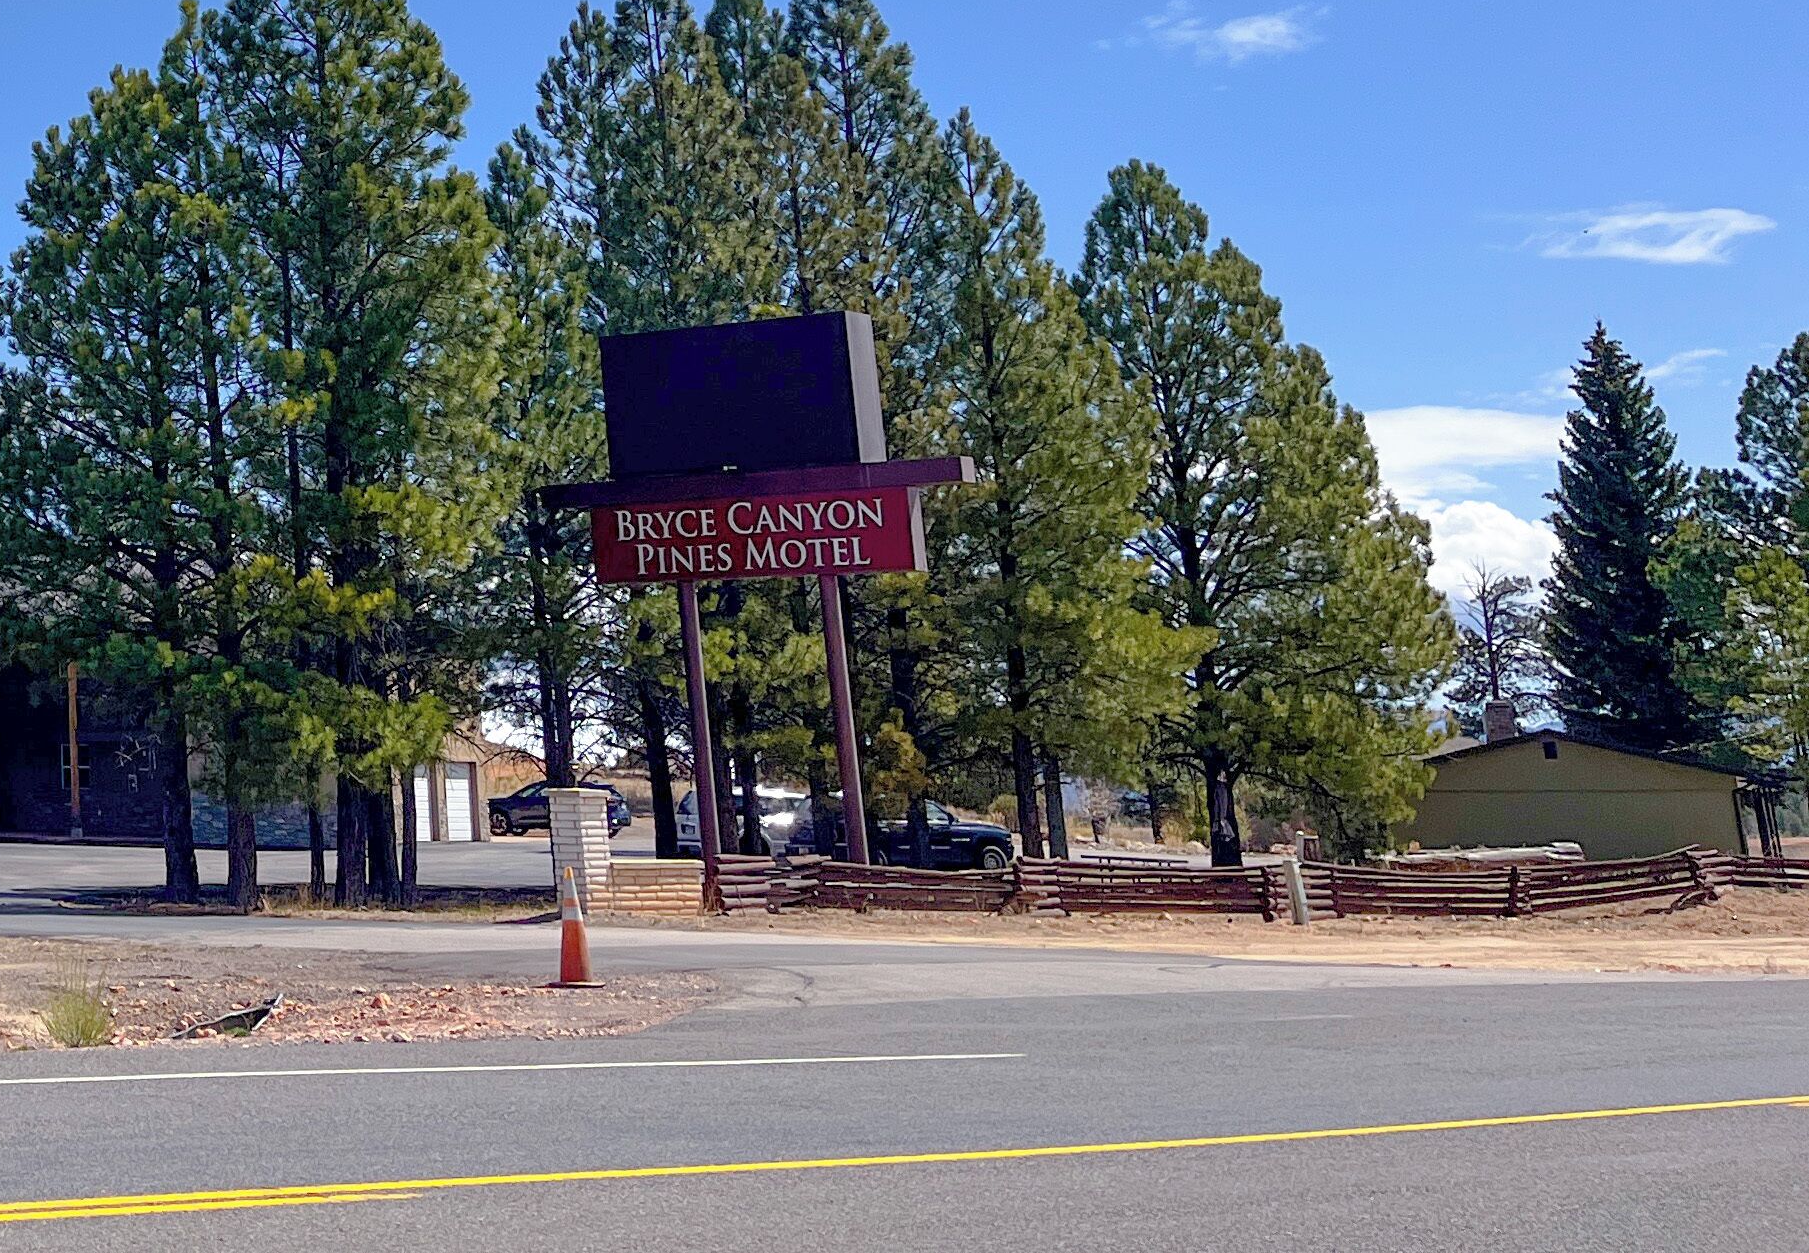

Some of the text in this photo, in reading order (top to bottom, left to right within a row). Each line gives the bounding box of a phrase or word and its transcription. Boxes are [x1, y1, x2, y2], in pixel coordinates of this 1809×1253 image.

[615, 498, 883, 541] BRYCE CANYON
[636, 536, 871, 575] PINES MOTEL
